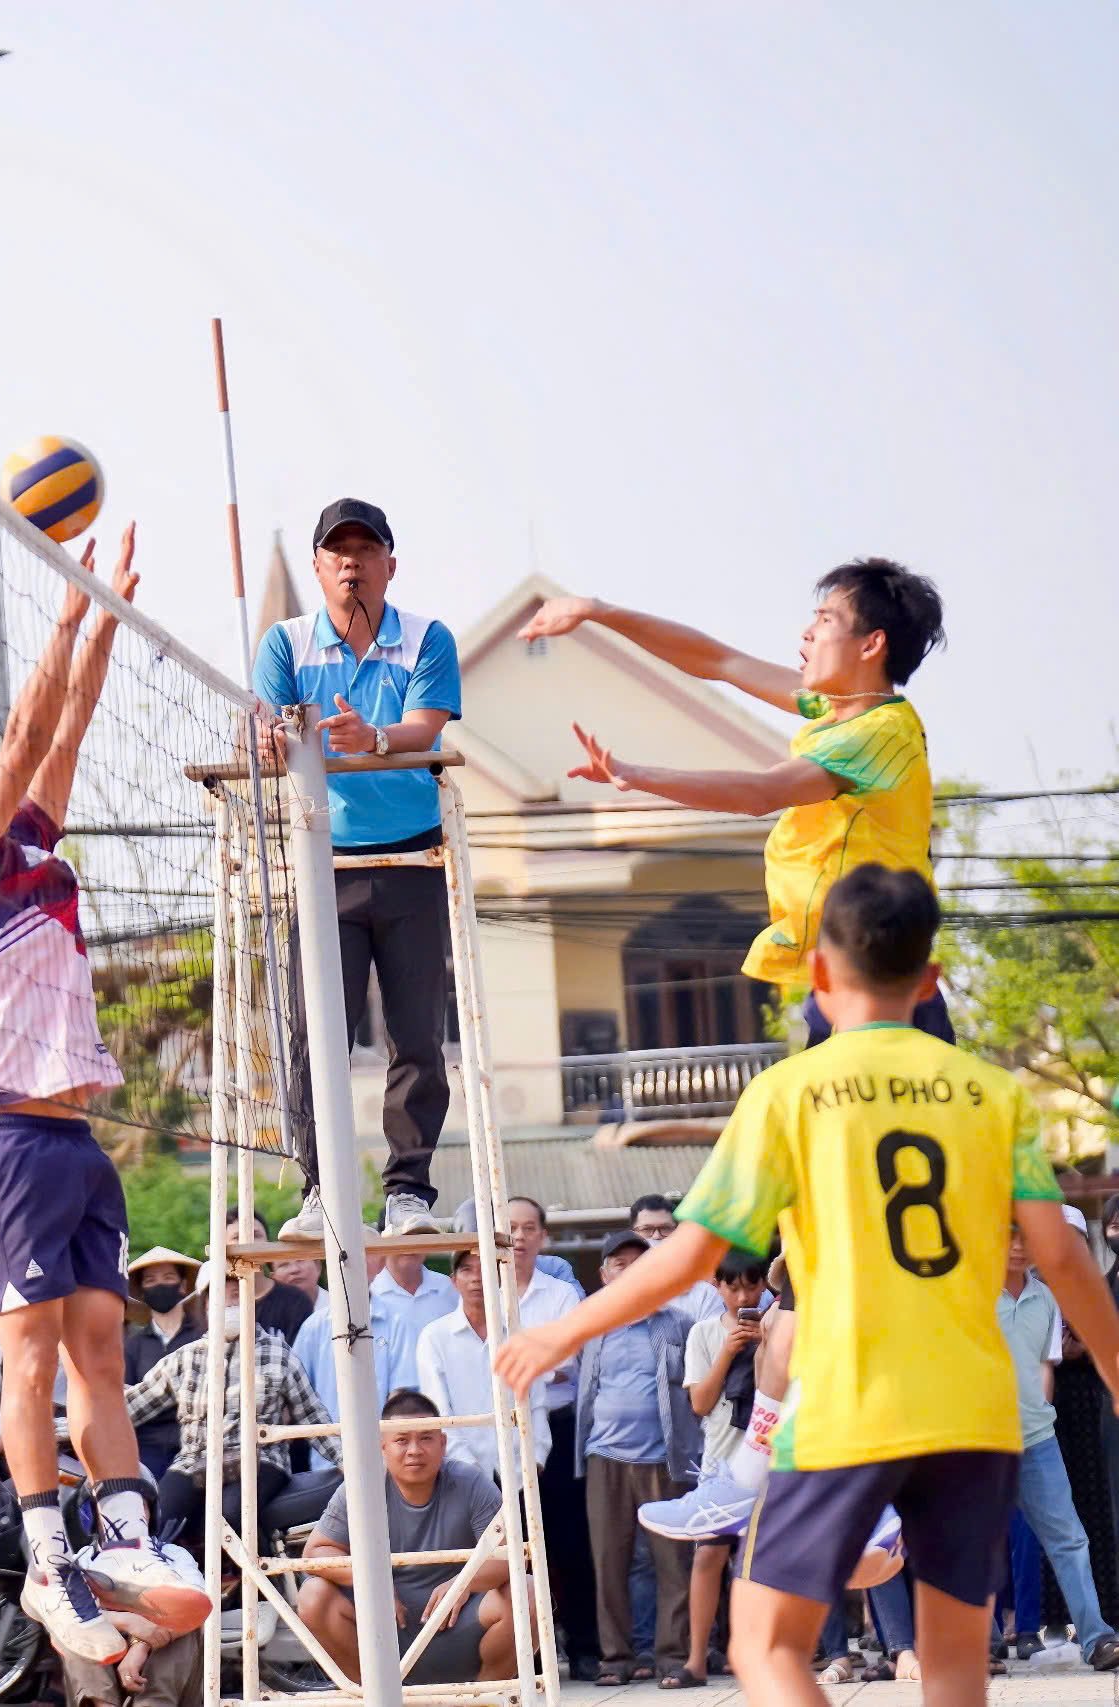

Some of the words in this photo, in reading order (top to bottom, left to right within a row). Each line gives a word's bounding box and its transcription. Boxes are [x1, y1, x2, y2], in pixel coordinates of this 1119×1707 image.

[808, 1075, 877, 1112] KHU
[967, 1078, 984, 1106] 9
[876, 1129, 961, 1278] 8
